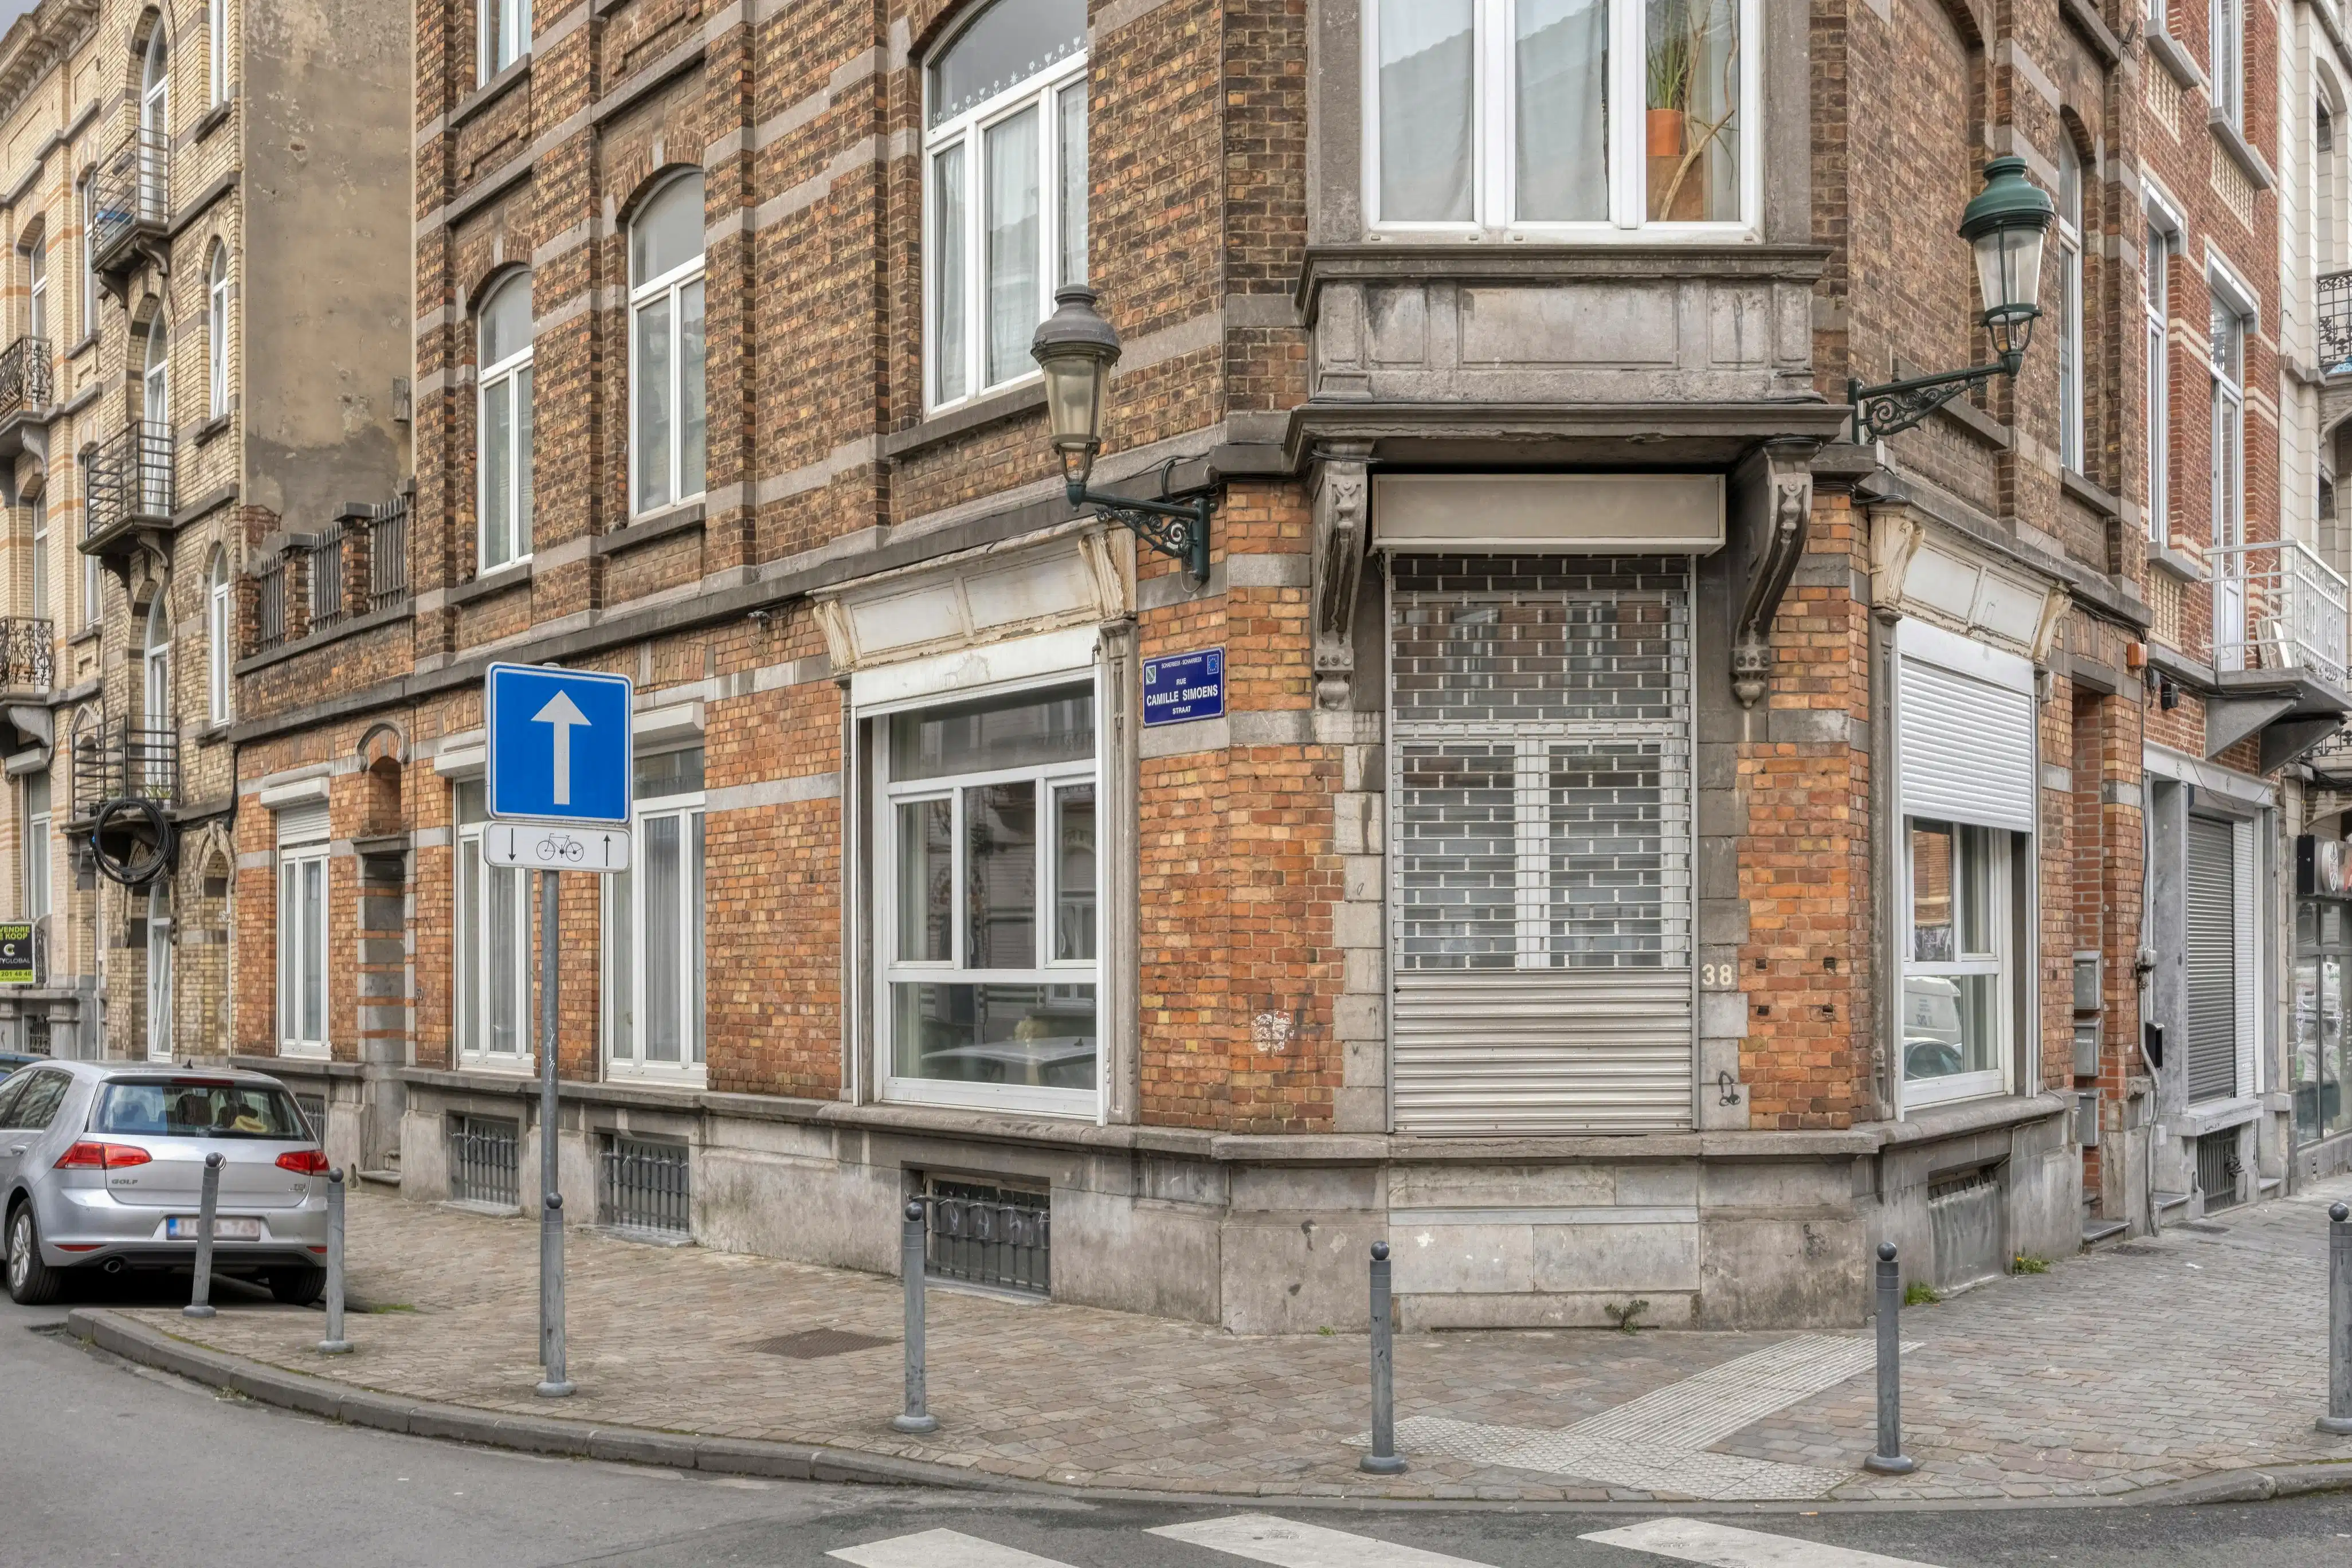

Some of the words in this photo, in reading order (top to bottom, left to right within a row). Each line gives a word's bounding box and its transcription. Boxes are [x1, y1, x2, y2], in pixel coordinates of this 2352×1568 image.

[1147, 691, 1179, 707] CAMILLE
[1182, 684, 1218, 701] SIMOENS
[1173, 705, 1191, 715] STRAAT
[1702, 963, 1732, 986] 38
